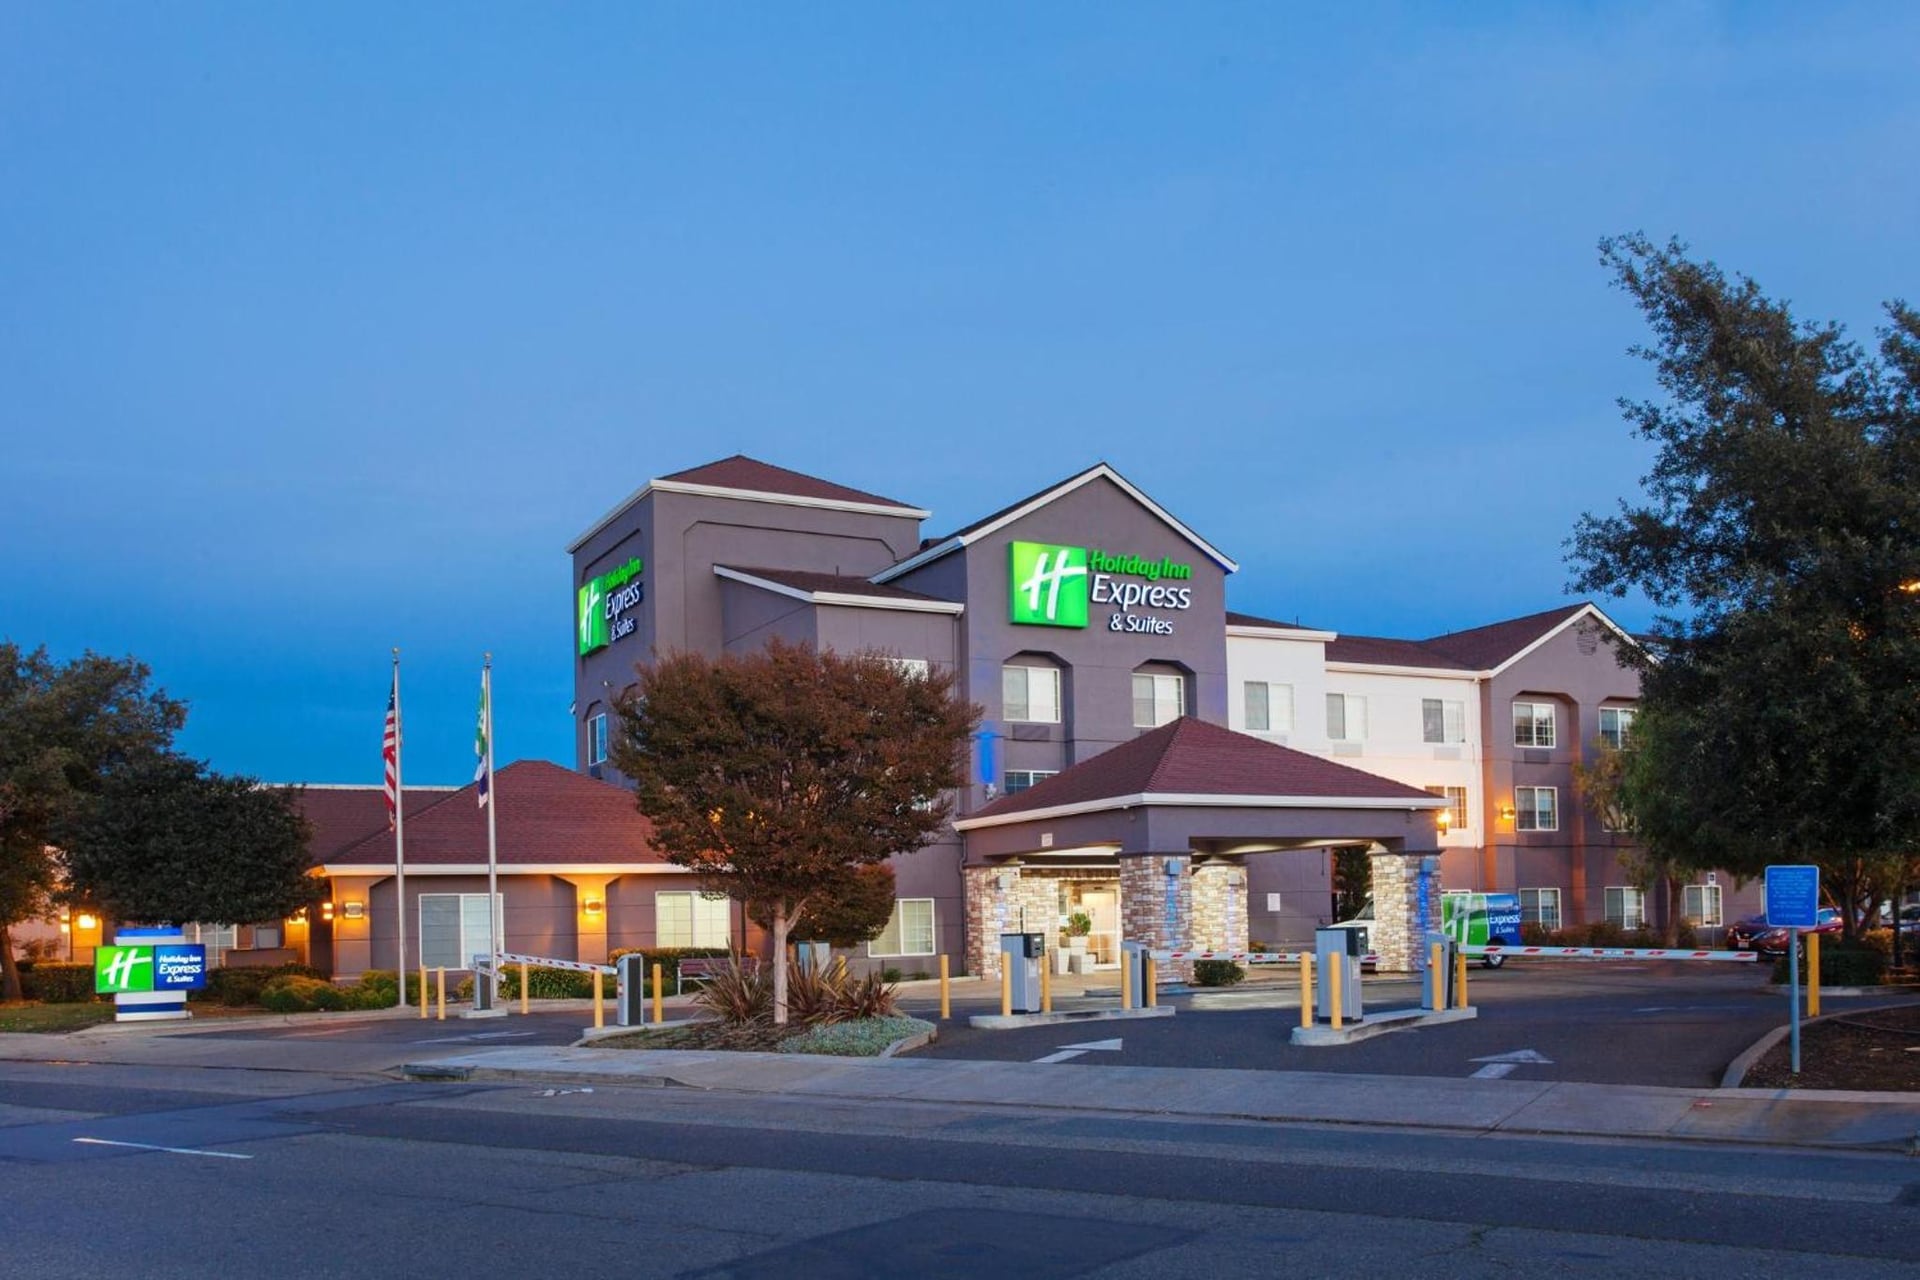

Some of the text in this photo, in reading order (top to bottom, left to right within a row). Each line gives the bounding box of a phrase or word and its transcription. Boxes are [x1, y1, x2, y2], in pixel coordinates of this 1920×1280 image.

[1090, 550, 1191, 581] Holiday Inn
[605, 581, 640, 620] Express
[1092, 574, 1191, 612] Express
[617, 618, 634, 638] Suites
[1110, 613, 1173, 634] & Suites
[1490, 914, 1520, 925] Express
[159, 964, 201, 975] Express
